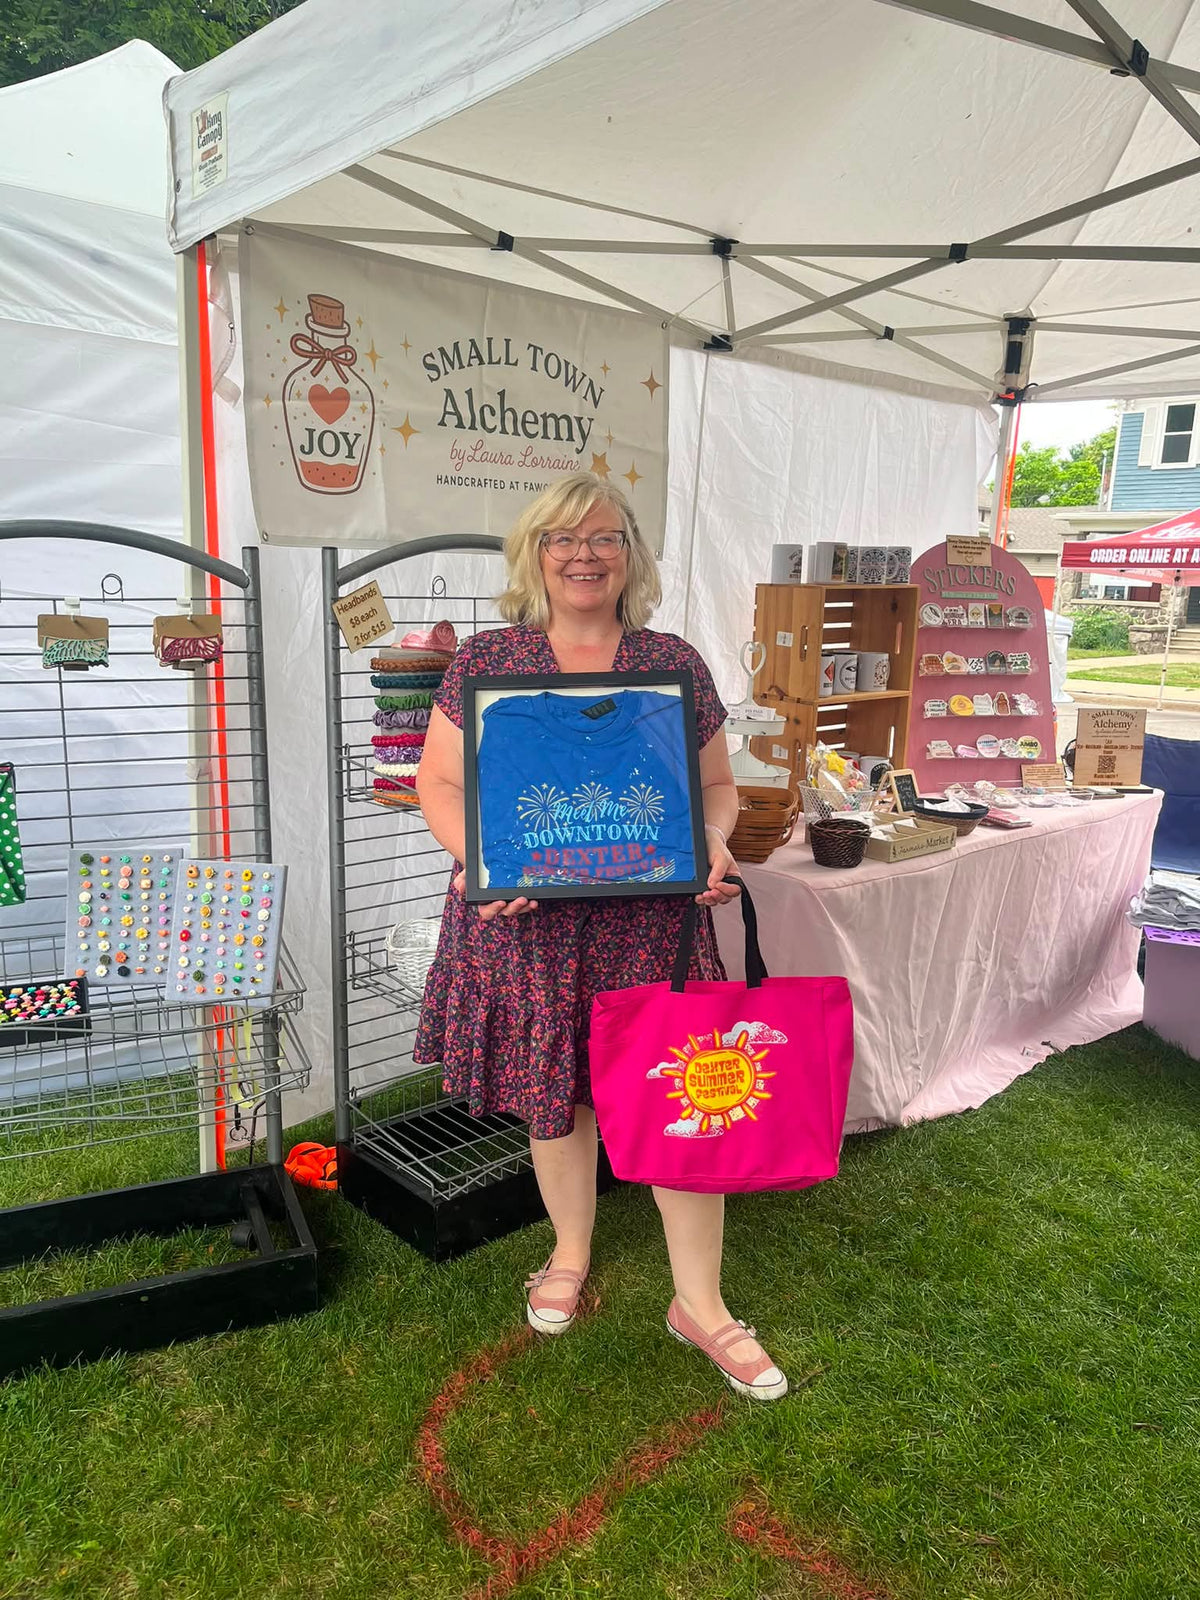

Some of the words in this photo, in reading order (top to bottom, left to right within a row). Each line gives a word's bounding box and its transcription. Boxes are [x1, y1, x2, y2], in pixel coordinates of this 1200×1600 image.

[197, 125, 223, 149] Canopy
[421, 336, 519, 383] SMALL
[526, 342, 605, 410] TOWN
[437, 387, 595, 455] Alchemy
[299, 427, 362, 460] JOY
[450, 439, 468, 472] by
[466, 439, 515, 467] Laura
[436, 474, 506, 490] HANDCRAFTED
[509, 480, 521, 491] AT
[1089, 548, 1128, 563] ORDER
[1128, 547, 1172, 564] ONLINE
[1172, 547, 1190, 564] AT
[923, 564, 1017, 597] STICKERS
[336, 587, 378, 615] Headbands
[350, 615, 361, 629] $8
[360, 606, 378, 622] each
[354, 635, 361, 645] 2
[360, 630, 371, 642] for
[371, 620, 387, 636] $15
[1091, 709, 1115, 721] SMALL
[1116, 709, 1137, 721] TOWN
[1093, 718, 1133, 730] Alchemy
[551, 799, 596, 824] Meet
[600, 799, 630, 822] Me
[522, 823, 661, 849] DOWNTOWN
[544, 842, 643, 866] DEXTER
